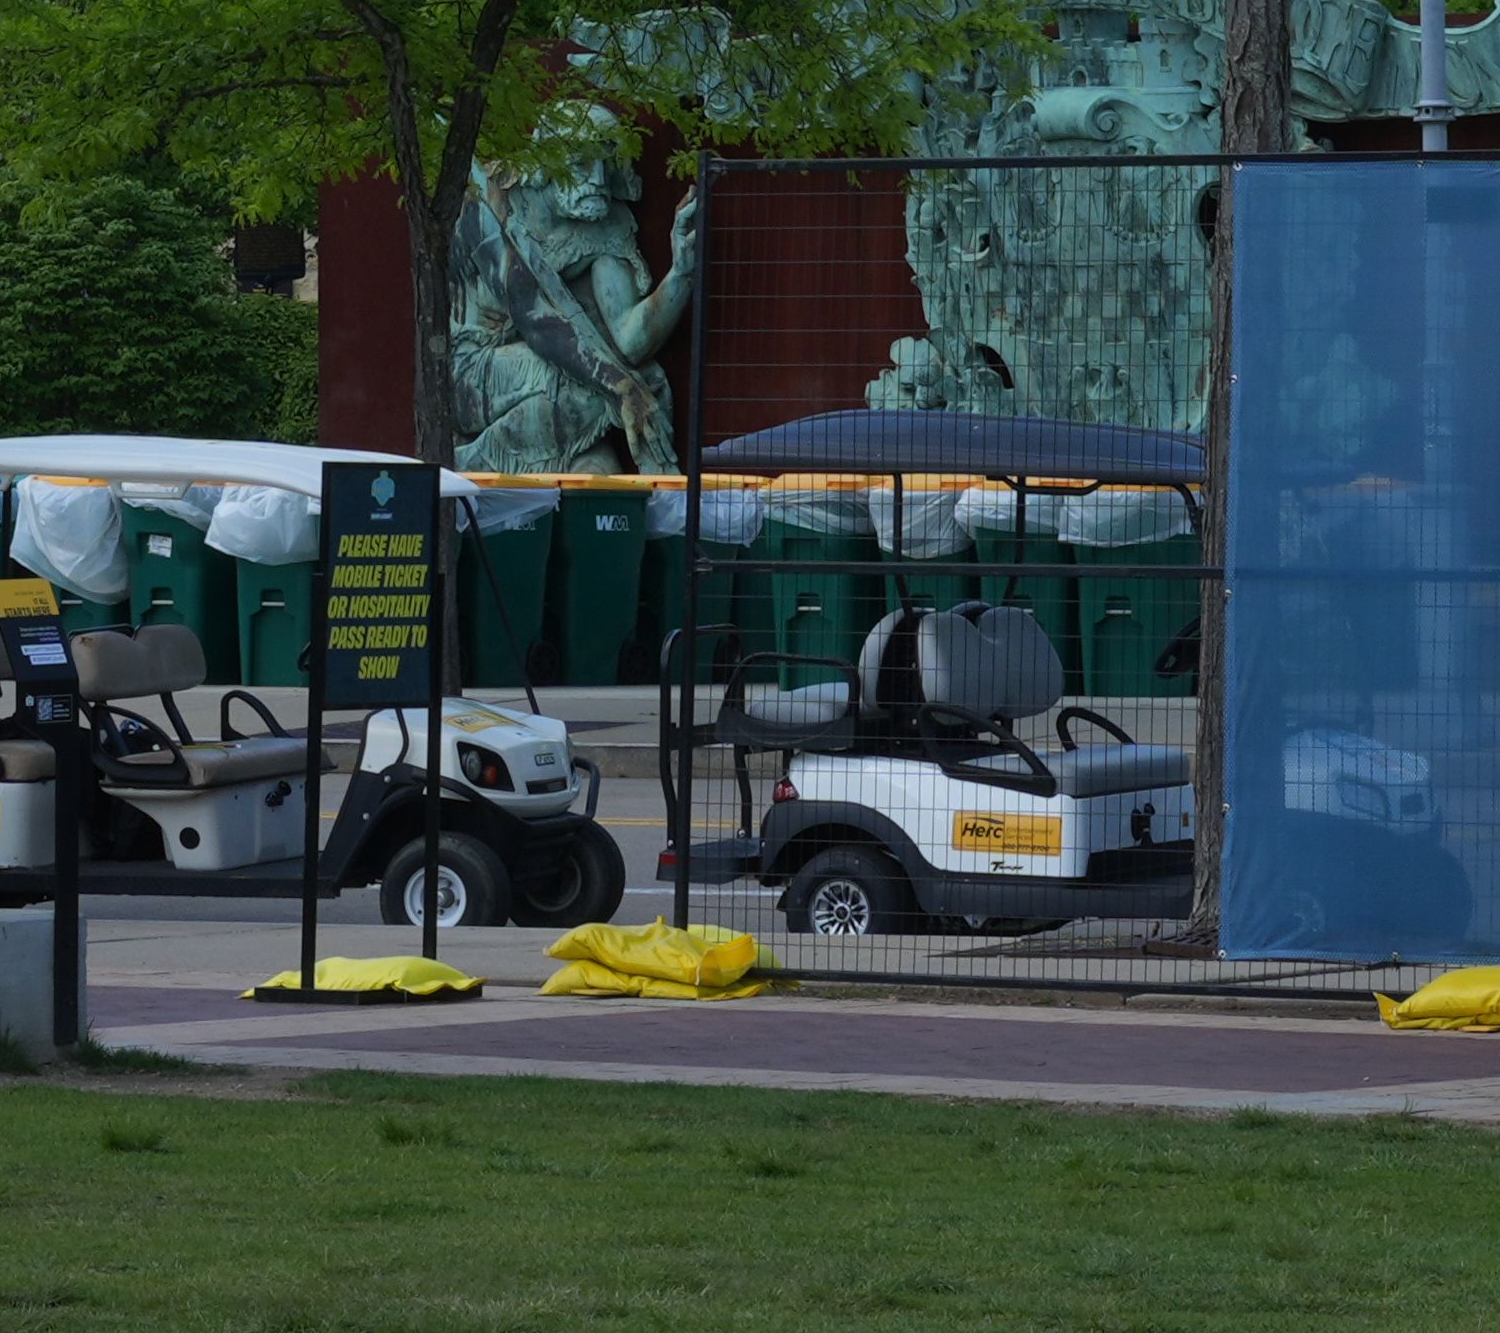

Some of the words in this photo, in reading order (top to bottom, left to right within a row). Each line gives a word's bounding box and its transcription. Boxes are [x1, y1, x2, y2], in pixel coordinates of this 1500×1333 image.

[595, 515, 630, 532] WM
[337, 534, 388, 558] PLEASE
[387, 534, 424, 557] HAVE
[331, 565, 383, 588] MOBILE
[383, 564, 429, 588] TICKET
[31, 605, 51, 616] HERE
[327, 595, 349, 619] OR
[348, 594, 431, 619] HOSPITALITY
[328, 626, 365, 650] PASS
[365, 625, 411, 649] READY
[410, 625, 428, 648] TO
[357, 656, 400, 679] SHOW
[961, 822, 1004, 839] Herc
